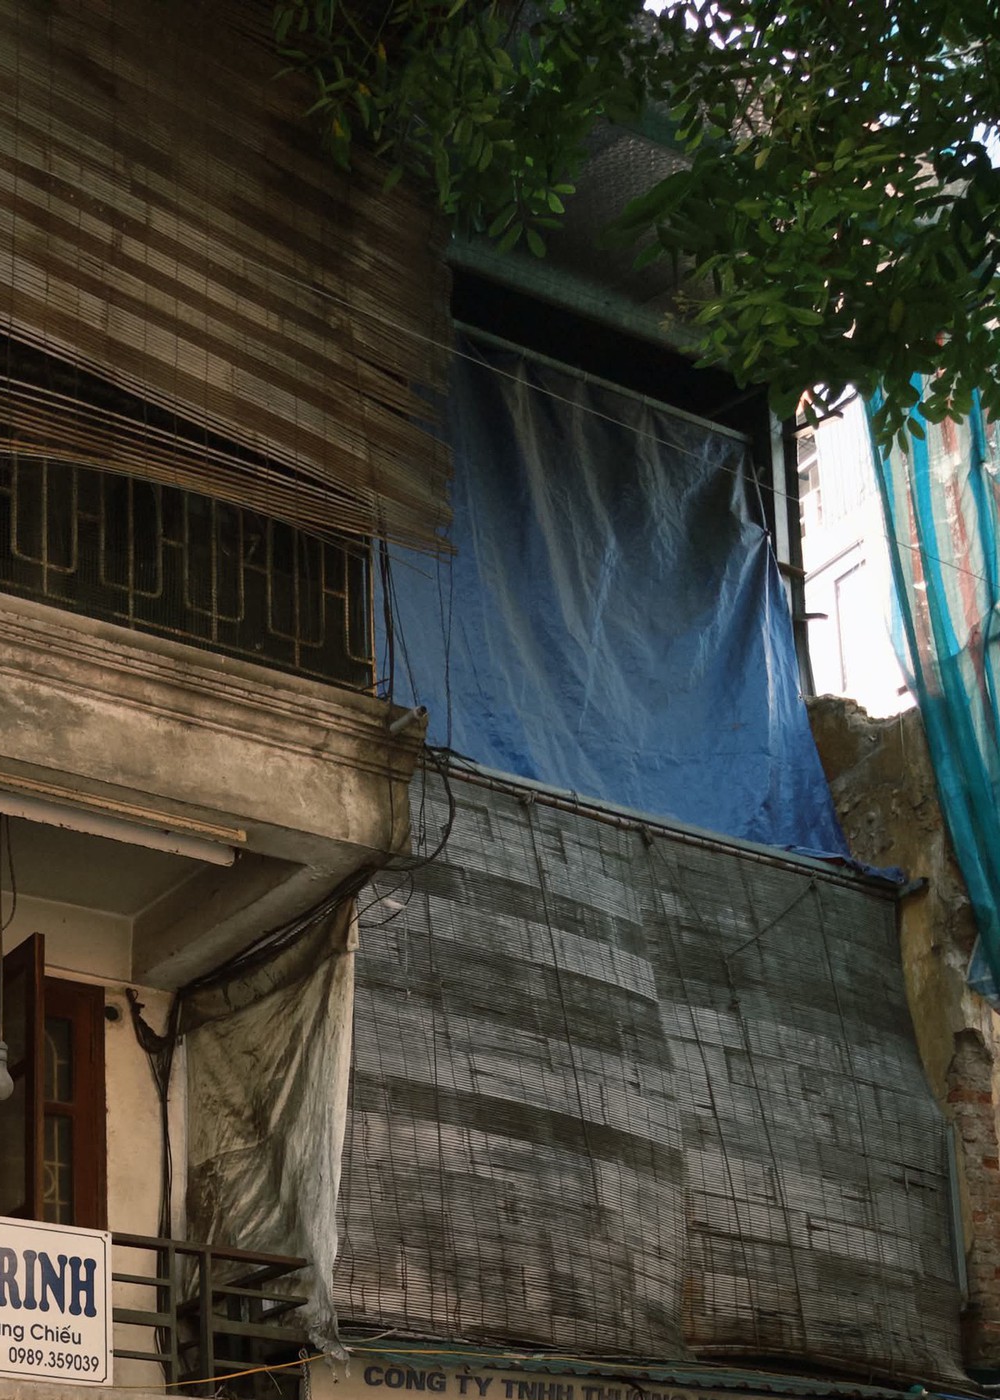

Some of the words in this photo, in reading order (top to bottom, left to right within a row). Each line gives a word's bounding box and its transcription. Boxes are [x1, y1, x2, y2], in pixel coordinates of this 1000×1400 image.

[30, 1324, 82, 1345] Chiếu
[8, 1346, 99, 1373] 0989.359039
[455, 1372, 493, 1398] TY
